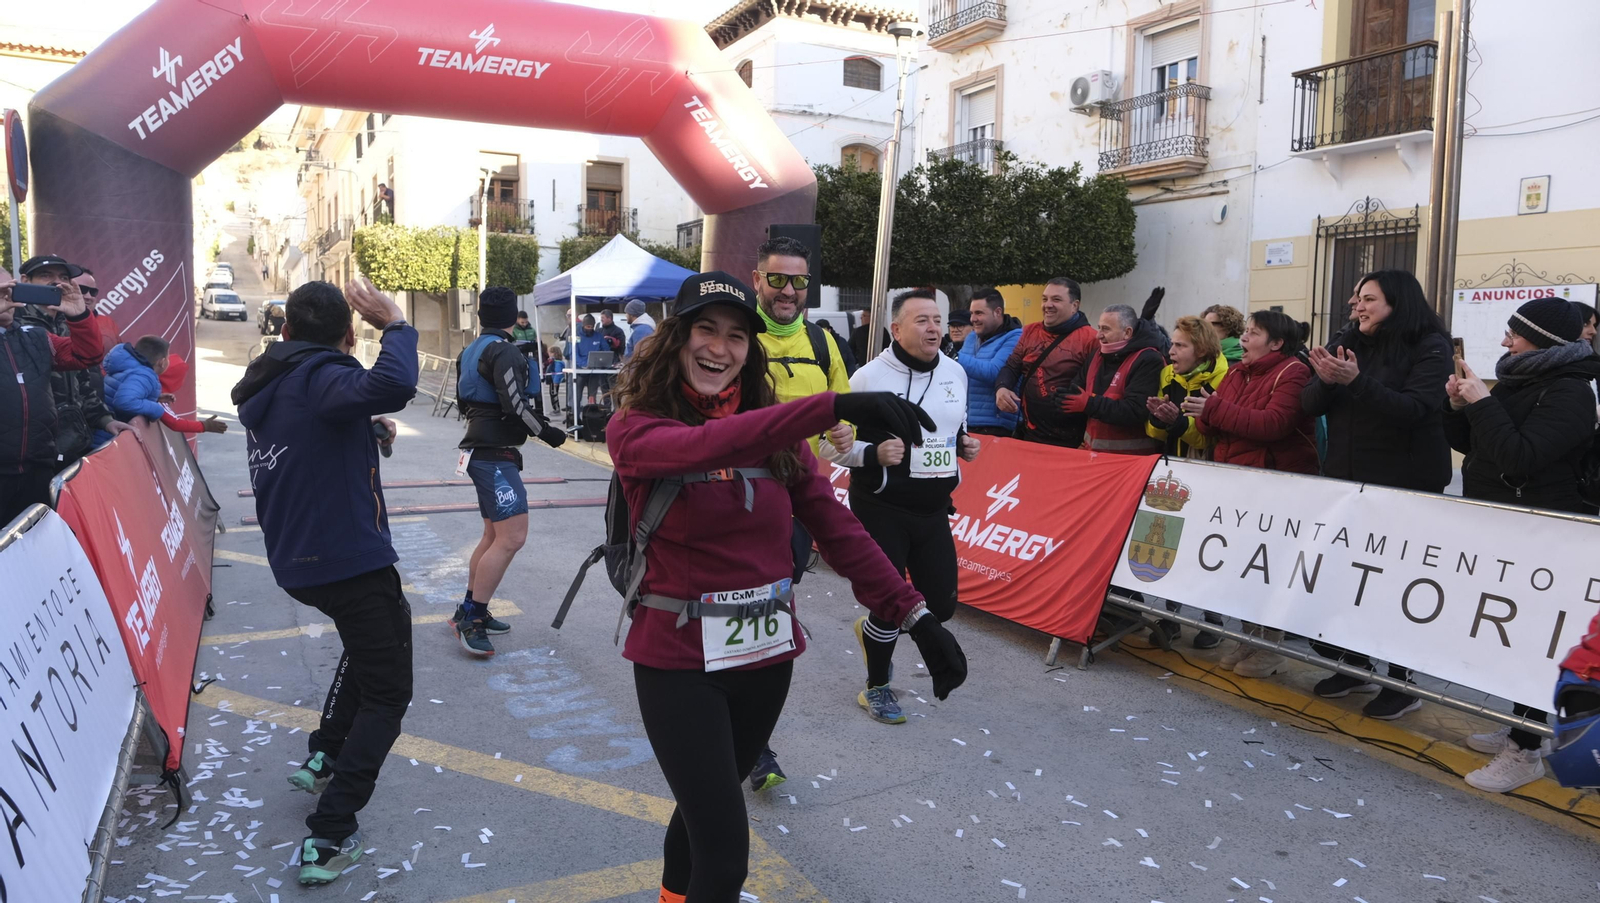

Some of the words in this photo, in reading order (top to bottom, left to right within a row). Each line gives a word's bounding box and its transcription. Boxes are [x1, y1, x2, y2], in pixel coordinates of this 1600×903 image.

[128, 36, 244, 140] TEAMERGY
[418, 47, 551, 79] TEAMERGY
[684, 95, 768, 189] TEAMERGY
[94, 249, 164, 316] mergy.es
[700, 284, 746, 301] SERIUS
[1472, 288, 1555, 301] ANUNCIOS
[922, 451, 951, 467] 380
[1210, 506, 1554, 591] AYUNTAMIENTO
[718, 593, 728, 602] IV
[732, 590, 754, 601] CxM
[1198, 533, 1566, 659] CANTORI
[0, 589, 63, 710] AMIENTO
[58, 567, 82, 604] DE
[725, 616, 778, 646] 216
[0, 608, 111, 903] ANTORIA
